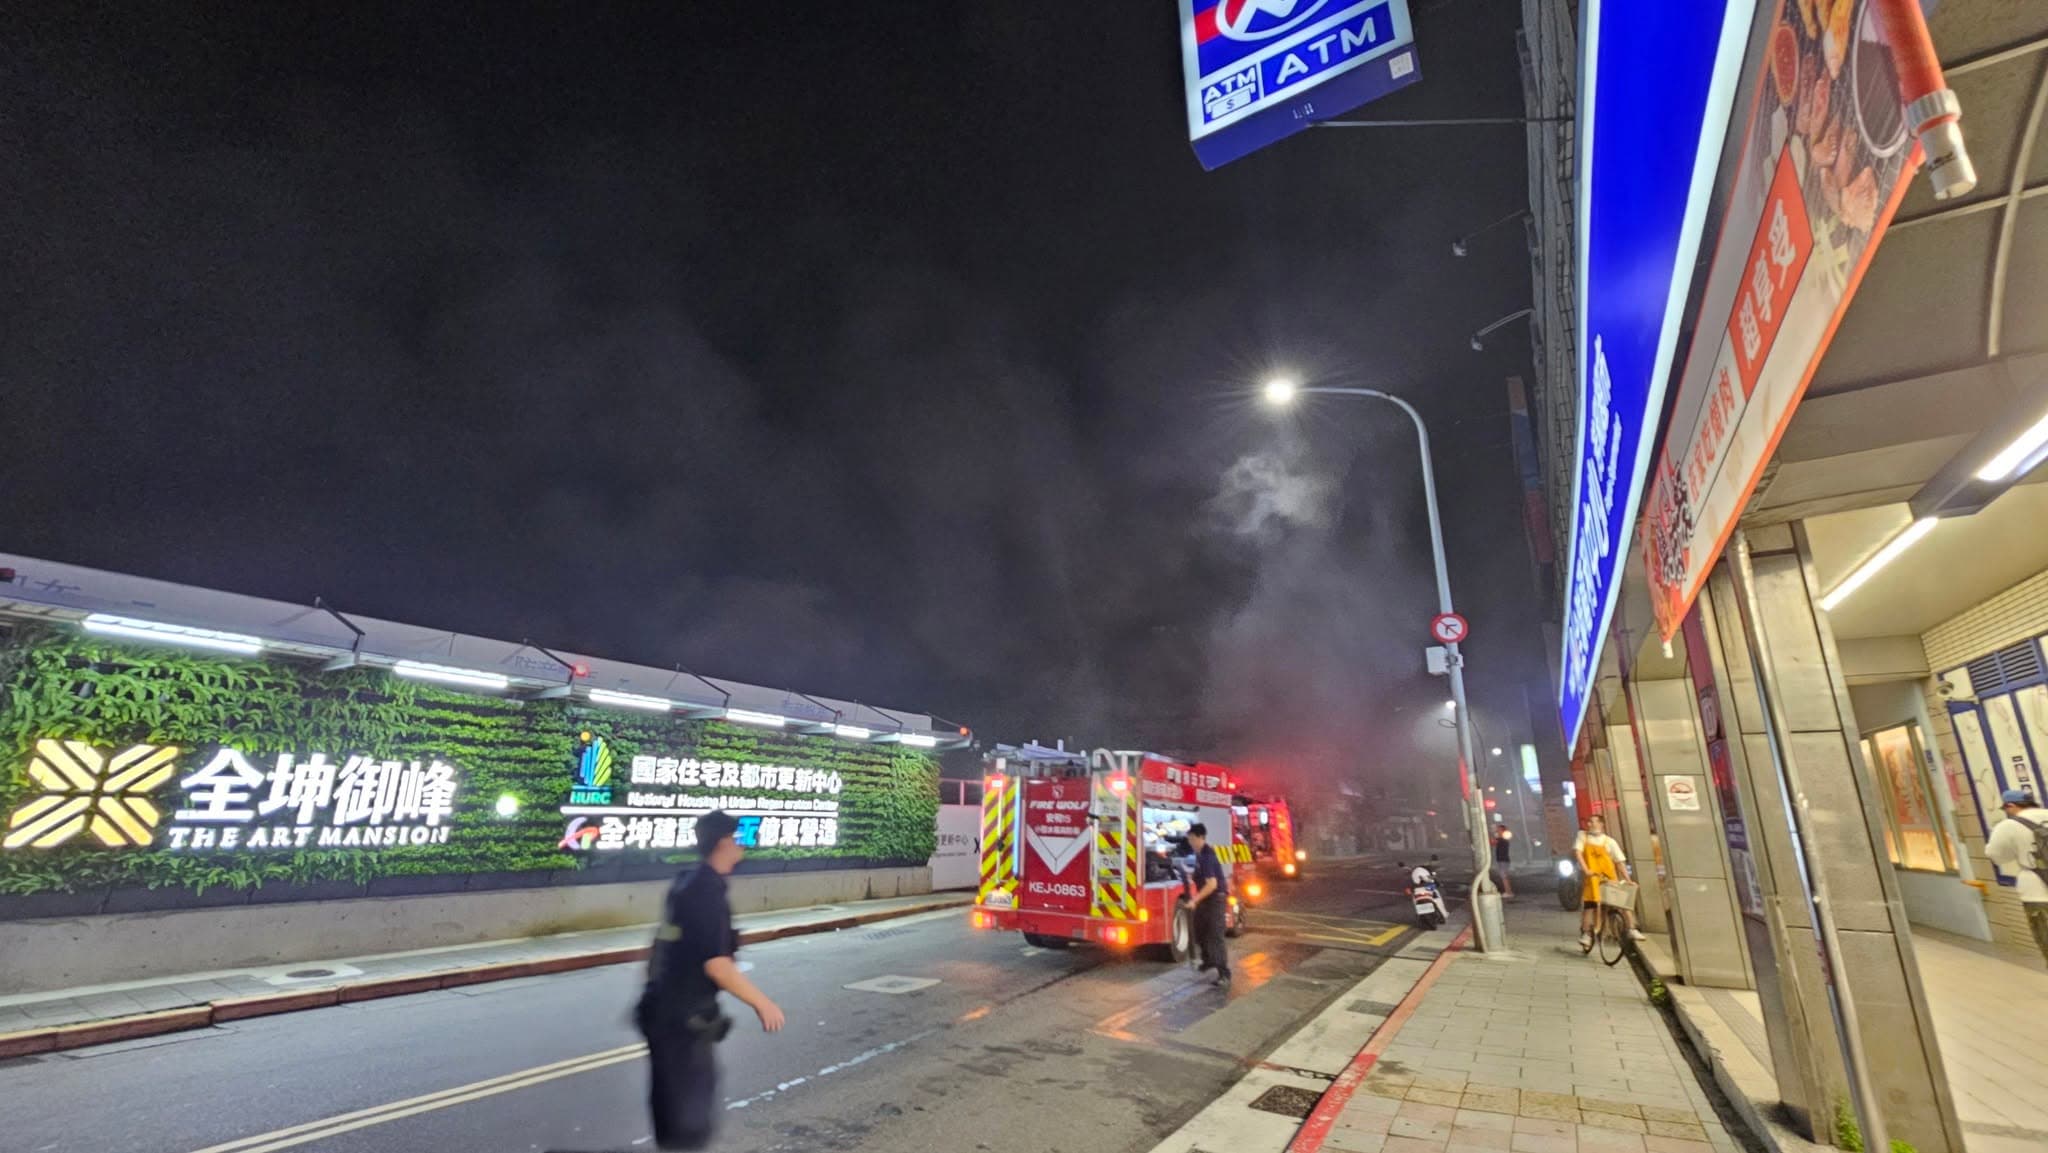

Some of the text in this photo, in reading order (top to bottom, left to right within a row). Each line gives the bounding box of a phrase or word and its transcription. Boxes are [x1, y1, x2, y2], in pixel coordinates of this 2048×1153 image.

[1276, 17, 1376, 85] ATM
[1204, 67, 1256, 104] ATM
[174, 748, 457, 826] 全坤御峰
[631, 755, 842, 794] 國家住宅及都市更新中心
[570, 791, 612, 804] HURC
[1029, 800, 1089, 810] FIRE WOLF
[168, 825, 454, 849] THE ART MANSION
[1029, 881, 1086, 897] KEJ-0863
